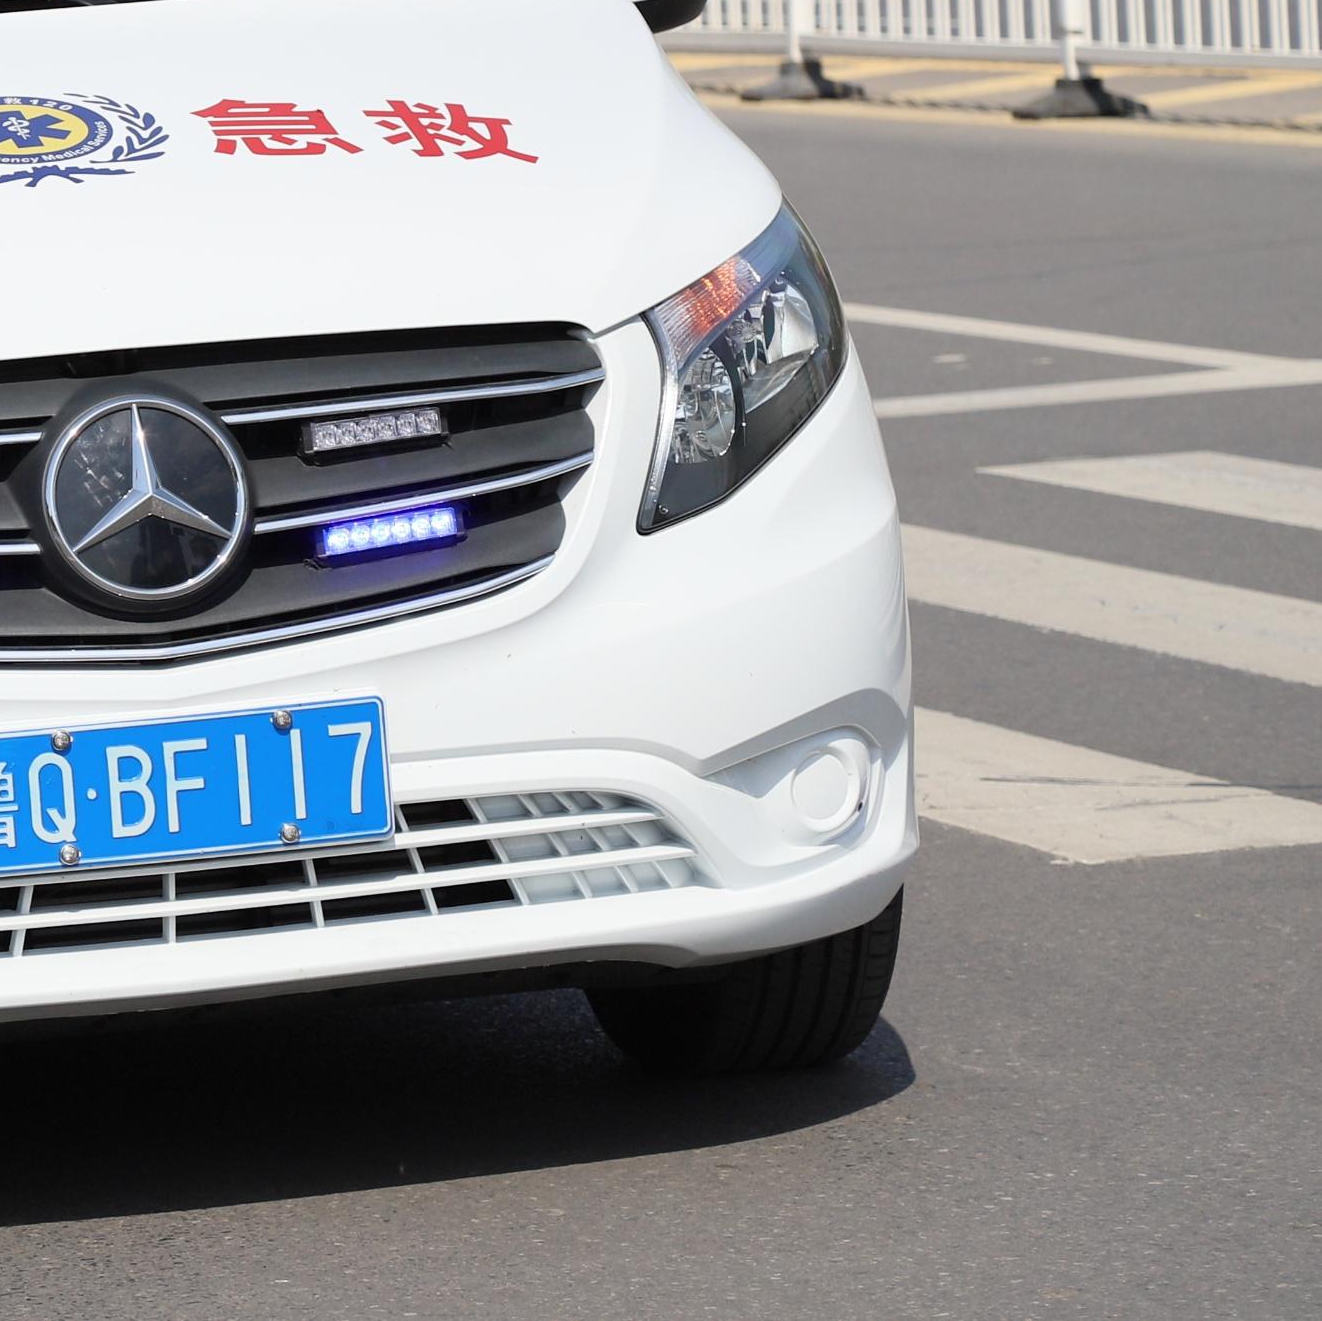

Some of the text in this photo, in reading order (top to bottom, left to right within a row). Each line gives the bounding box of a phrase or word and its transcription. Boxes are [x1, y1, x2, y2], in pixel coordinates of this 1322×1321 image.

[42, 144, 94, 162] Medical
[90, 121, 105, 148] Services
[189, 98, 539, 164] 急救
